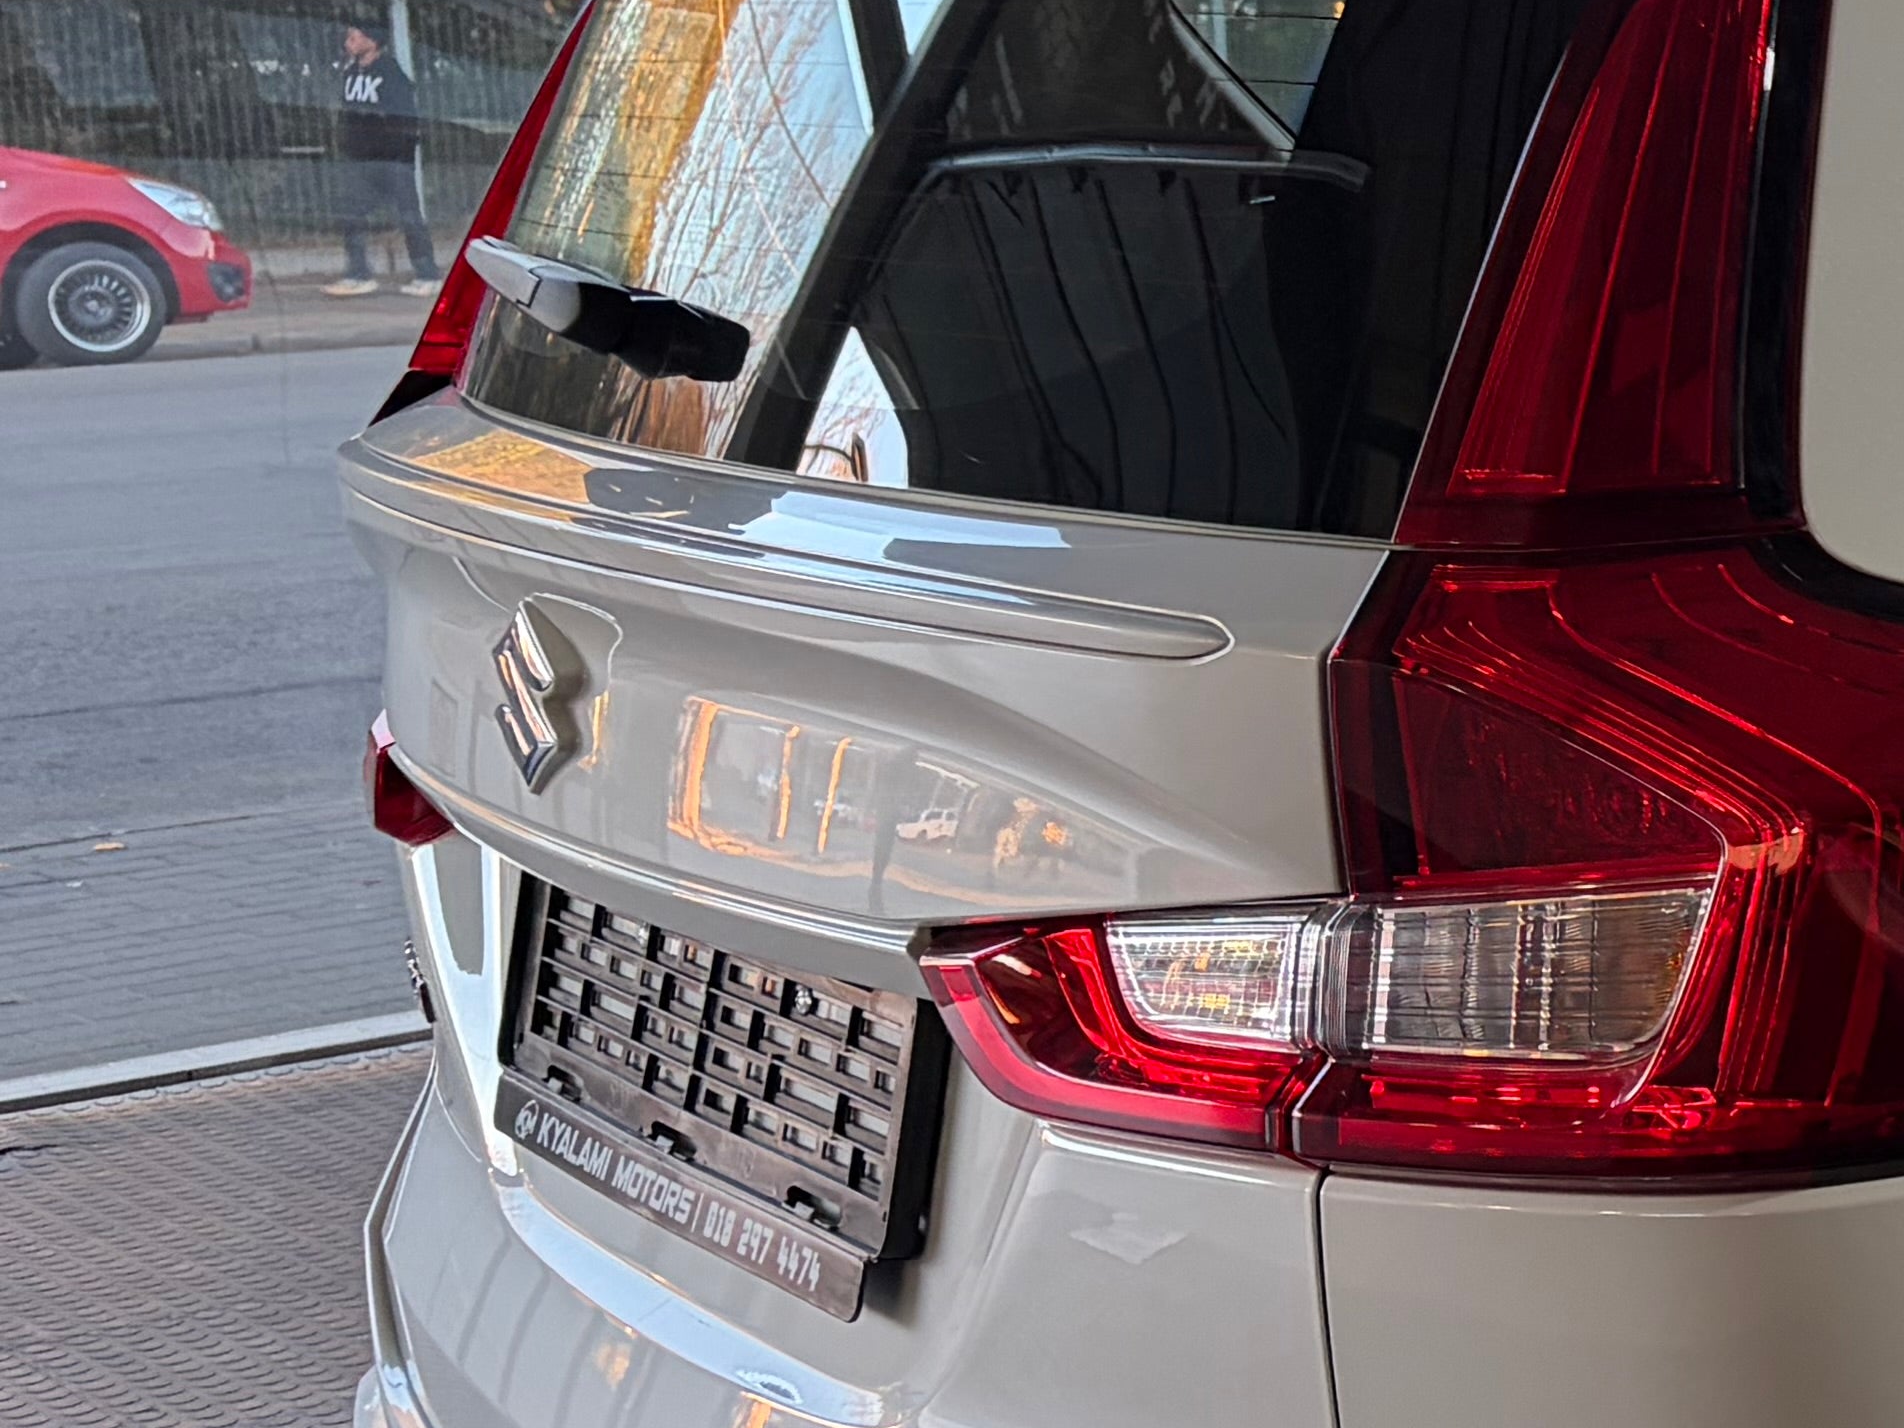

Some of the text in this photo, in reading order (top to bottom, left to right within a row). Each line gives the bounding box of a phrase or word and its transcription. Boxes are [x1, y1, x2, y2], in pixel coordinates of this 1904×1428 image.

[536, 1112, 613, 1181] KYALAMI
[611, 1155, 696, 1224] MOTORS
[736, 1218, 774, 1265] 297
[777, 1235, 820, 1292] 4474
